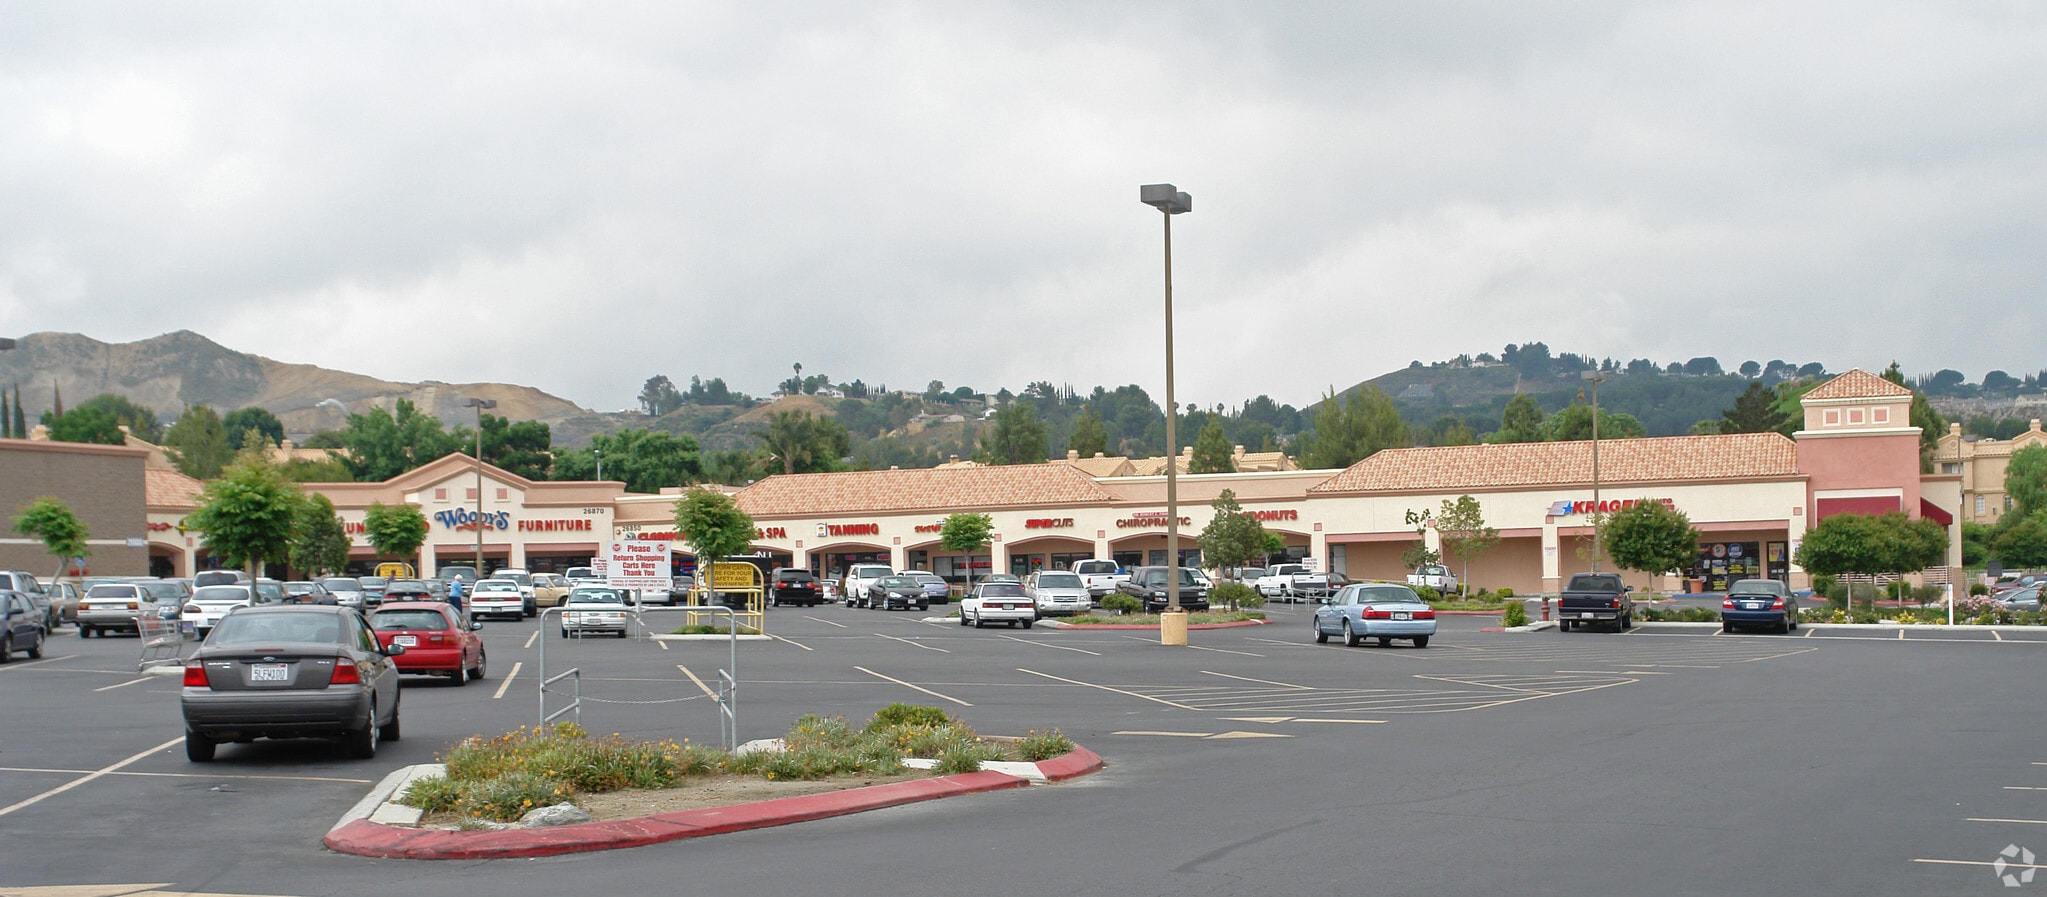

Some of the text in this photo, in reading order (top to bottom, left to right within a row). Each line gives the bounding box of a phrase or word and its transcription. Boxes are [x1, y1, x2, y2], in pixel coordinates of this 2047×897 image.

[1250, 509, 1298, 521] DONUTS
[518, 519, 592, 532] FURNITURE
[1025, 518, 1074, 528] SUPERCUTS
[1116, 516, 1192, 528] CHIROPRATIC
[766, 527, 787, 539] SPA
[828, 523, 879, 537] TANNING
[627, 544, 651, 552] Please
[636, 554, 665, 562] Shopping
